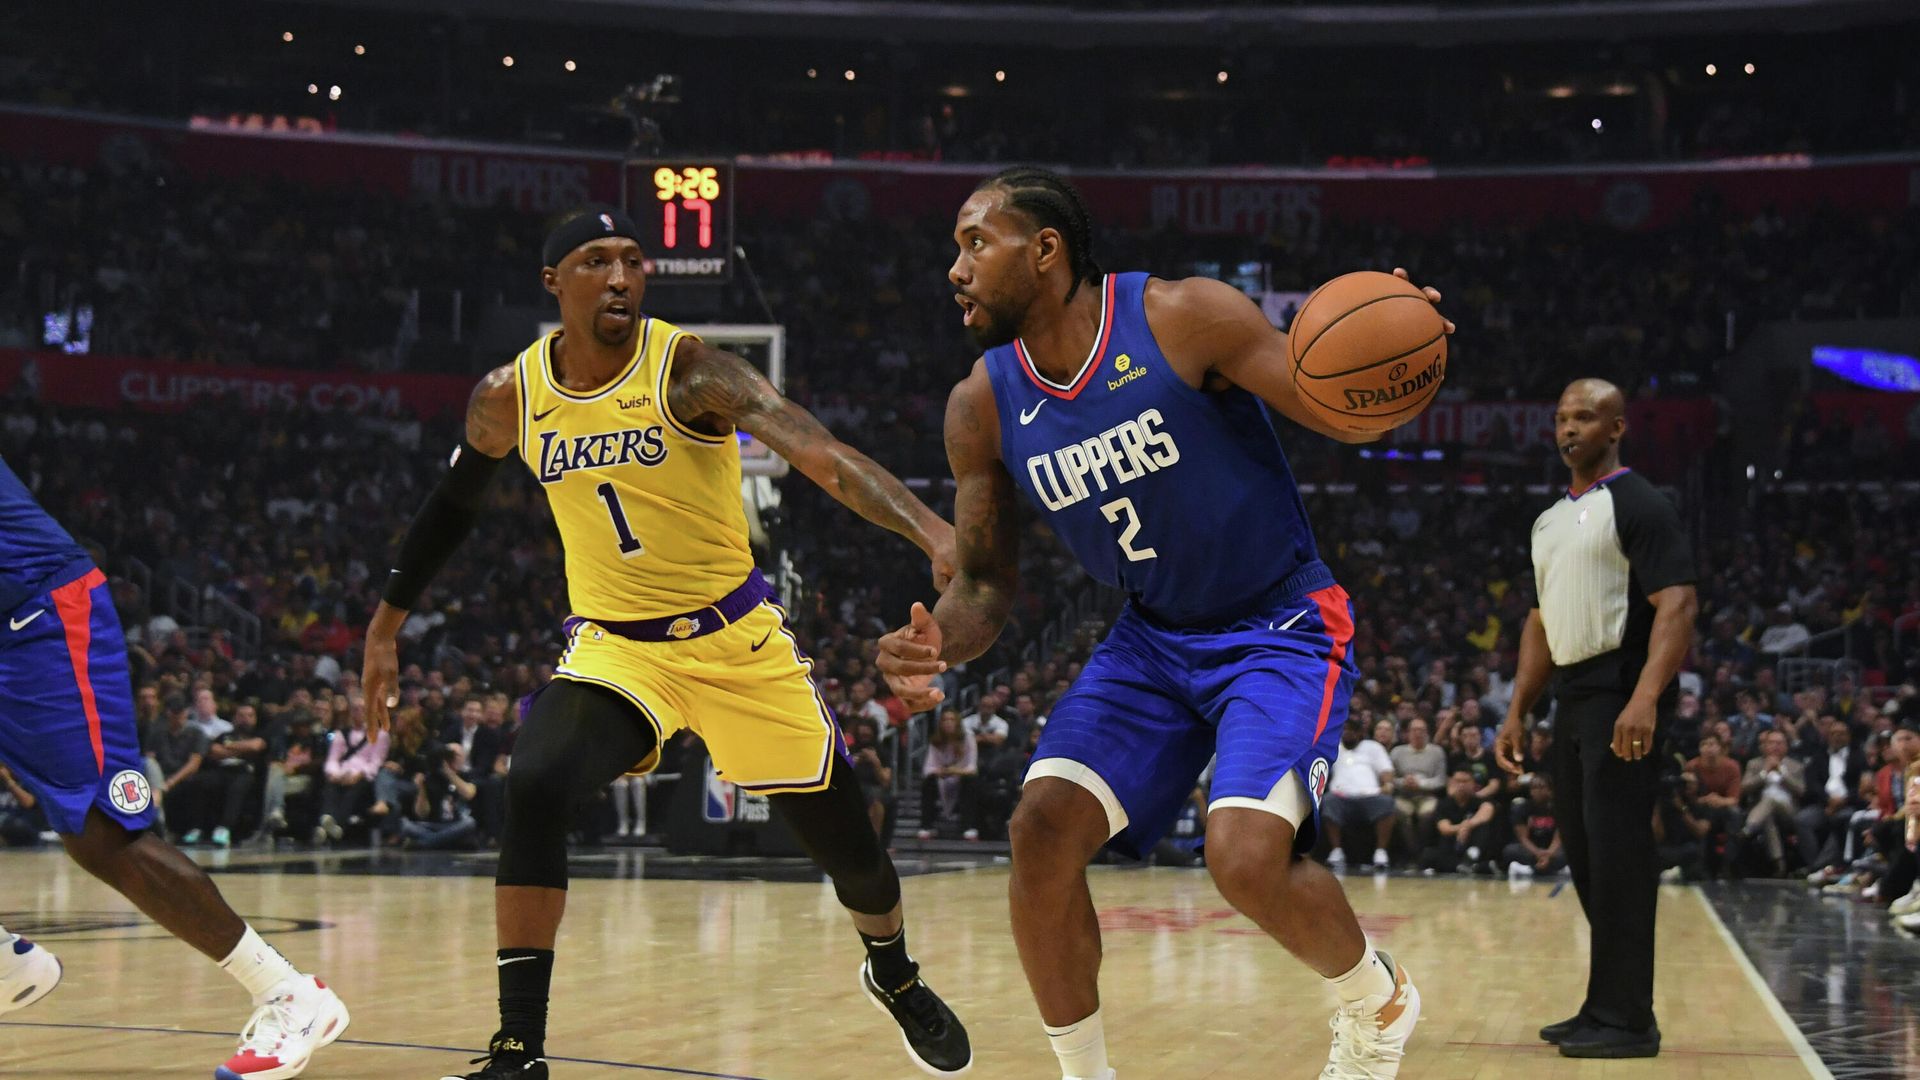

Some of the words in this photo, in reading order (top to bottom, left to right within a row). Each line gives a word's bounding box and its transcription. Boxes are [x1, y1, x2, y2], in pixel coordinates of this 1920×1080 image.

[654, 167, 719, 200] 9:26
[664, 199, 711, 248] 17
[656, 258, 726, 274] TISSOT
[119, 370, 401, 413] CLIPPRS.COM
[616, 394, 652, 410] wish
[1107, 366, 1147, 391] bumble
[1344, 354, 1441, 410] SPALDING
[539, 425, 669, 484] LAKERS
[1026, 408, 1181, 512] CLIPPERS
[597, 482, 644, 559] 1
[1100, 496, 1158, 562] 2
